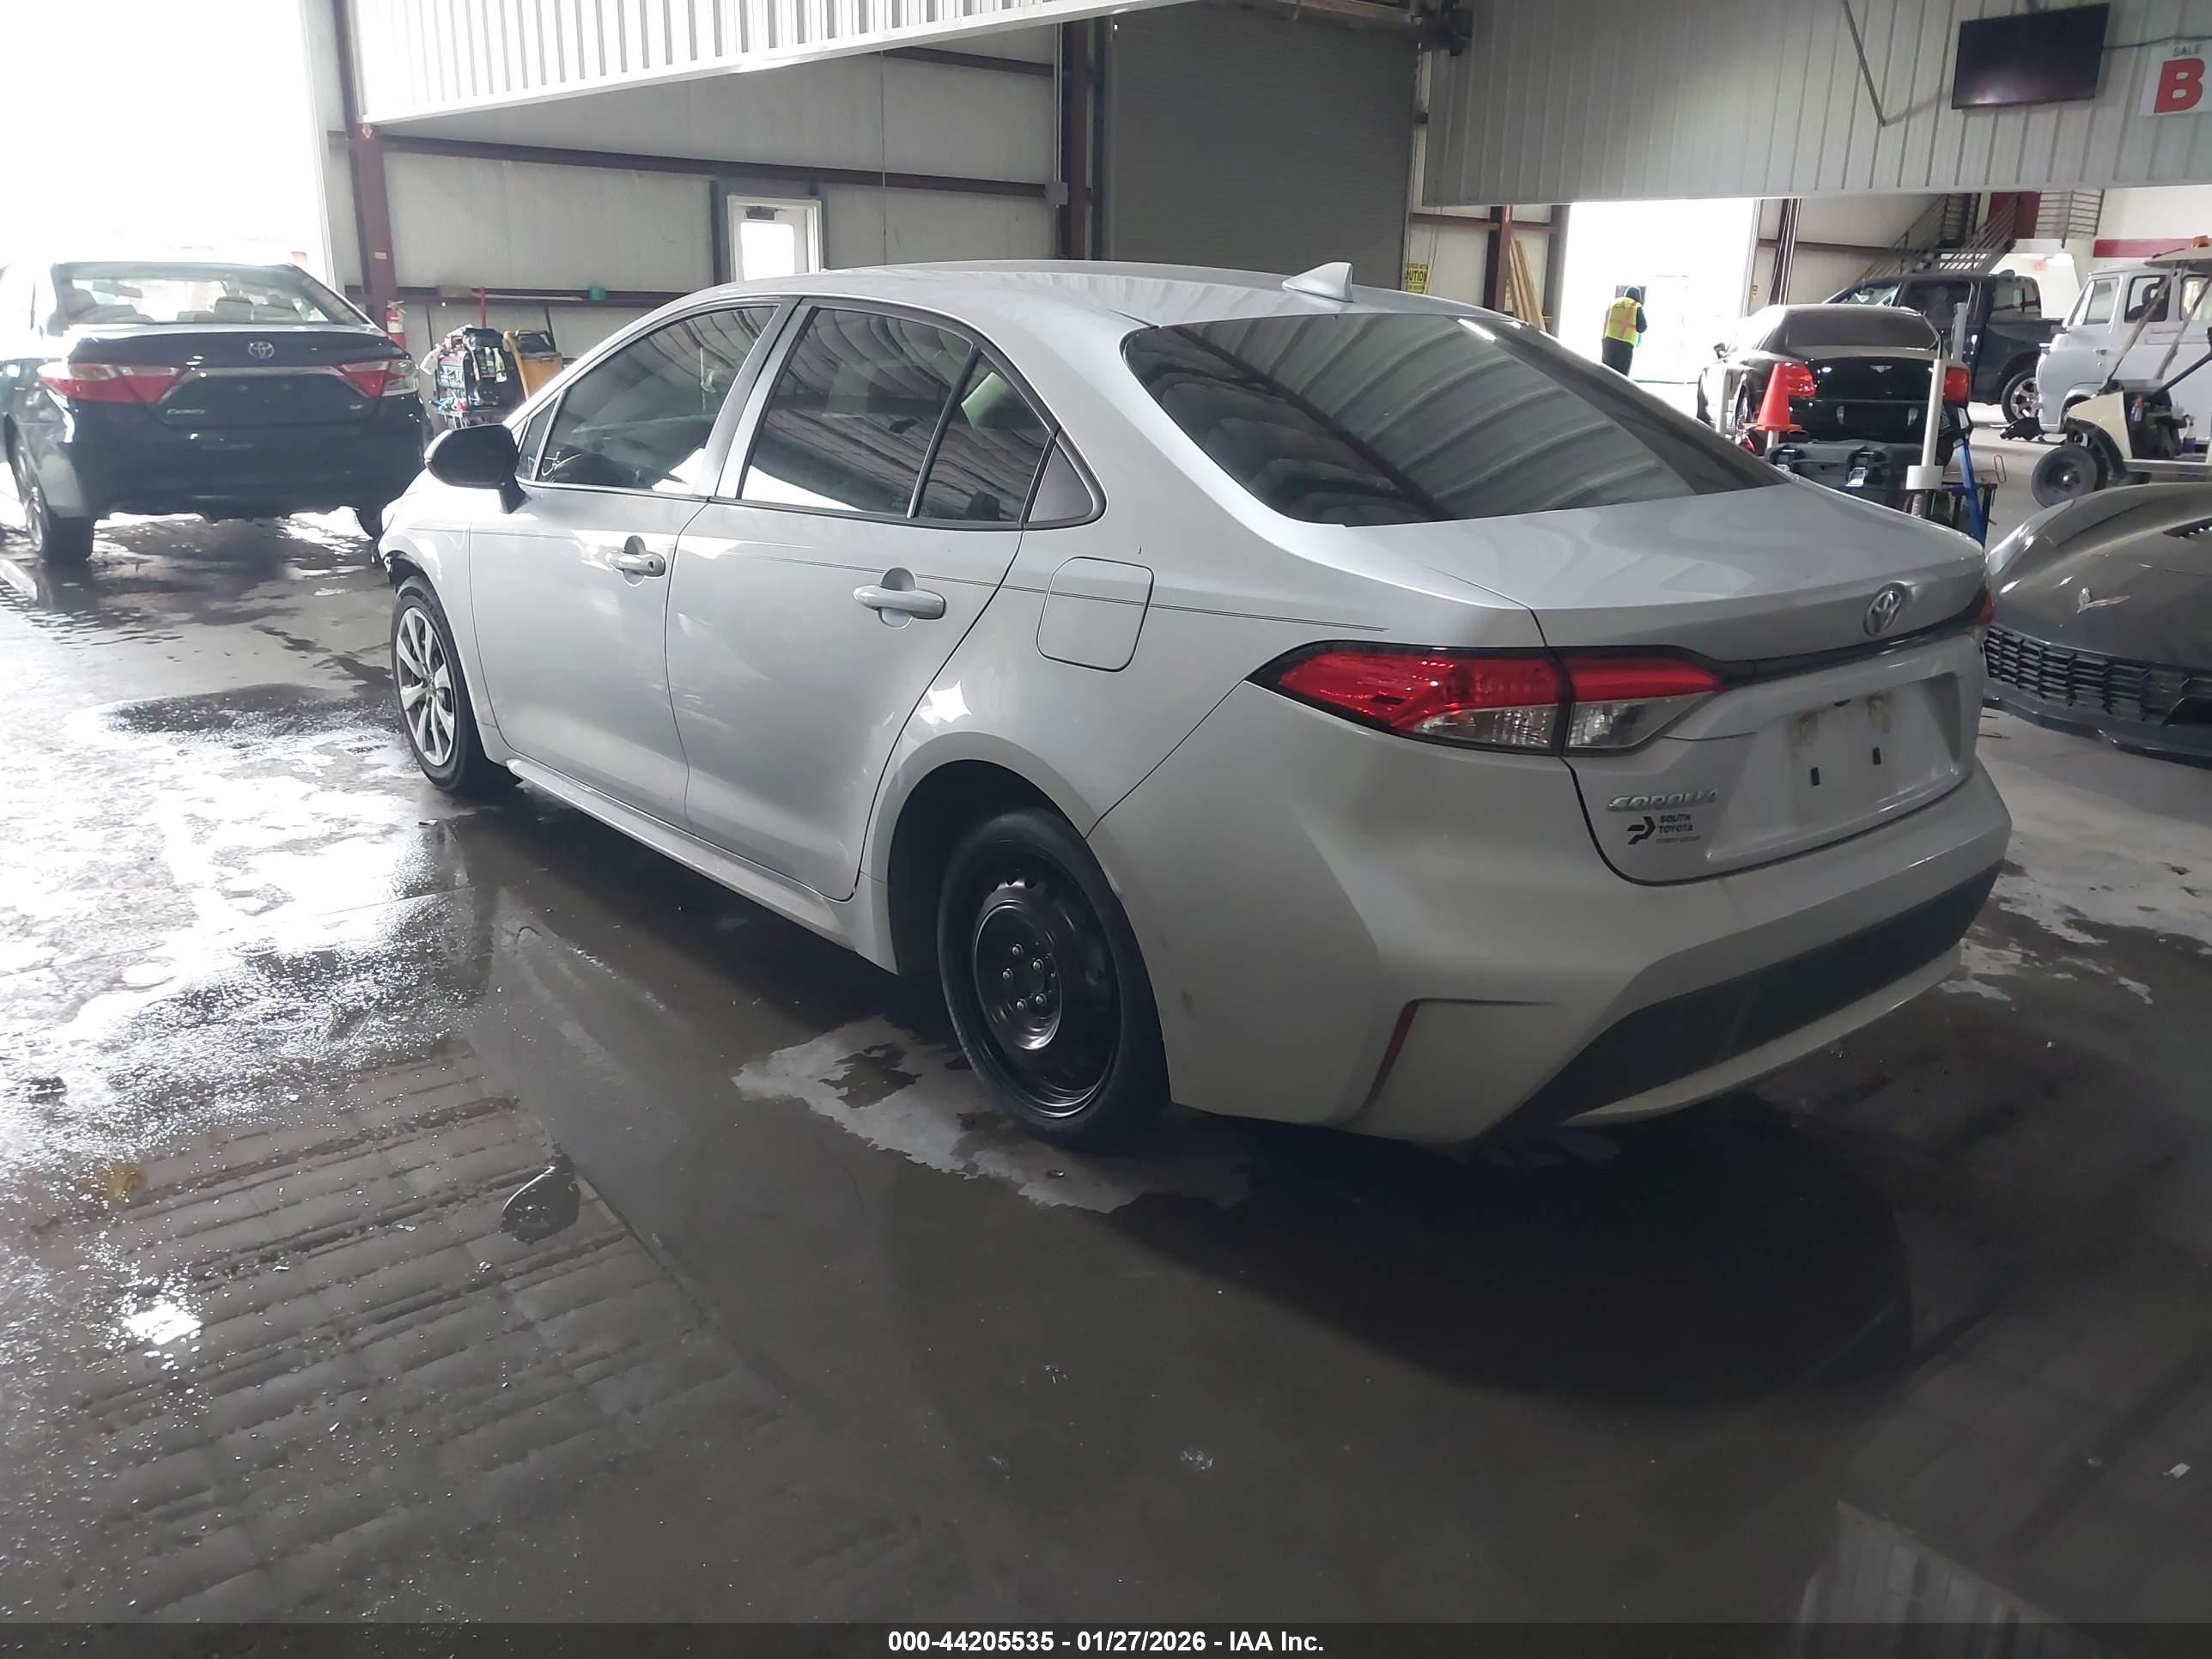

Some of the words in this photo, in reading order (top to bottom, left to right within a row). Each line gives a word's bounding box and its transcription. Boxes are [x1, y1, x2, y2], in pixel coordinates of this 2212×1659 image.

[2172, 44, 2201, 57] SALE
[2153, 58, 2205, 113] B
[1659, 813, 1691, 823] SOUTH
[1658, 824, 1693, 834] TOYOTA
